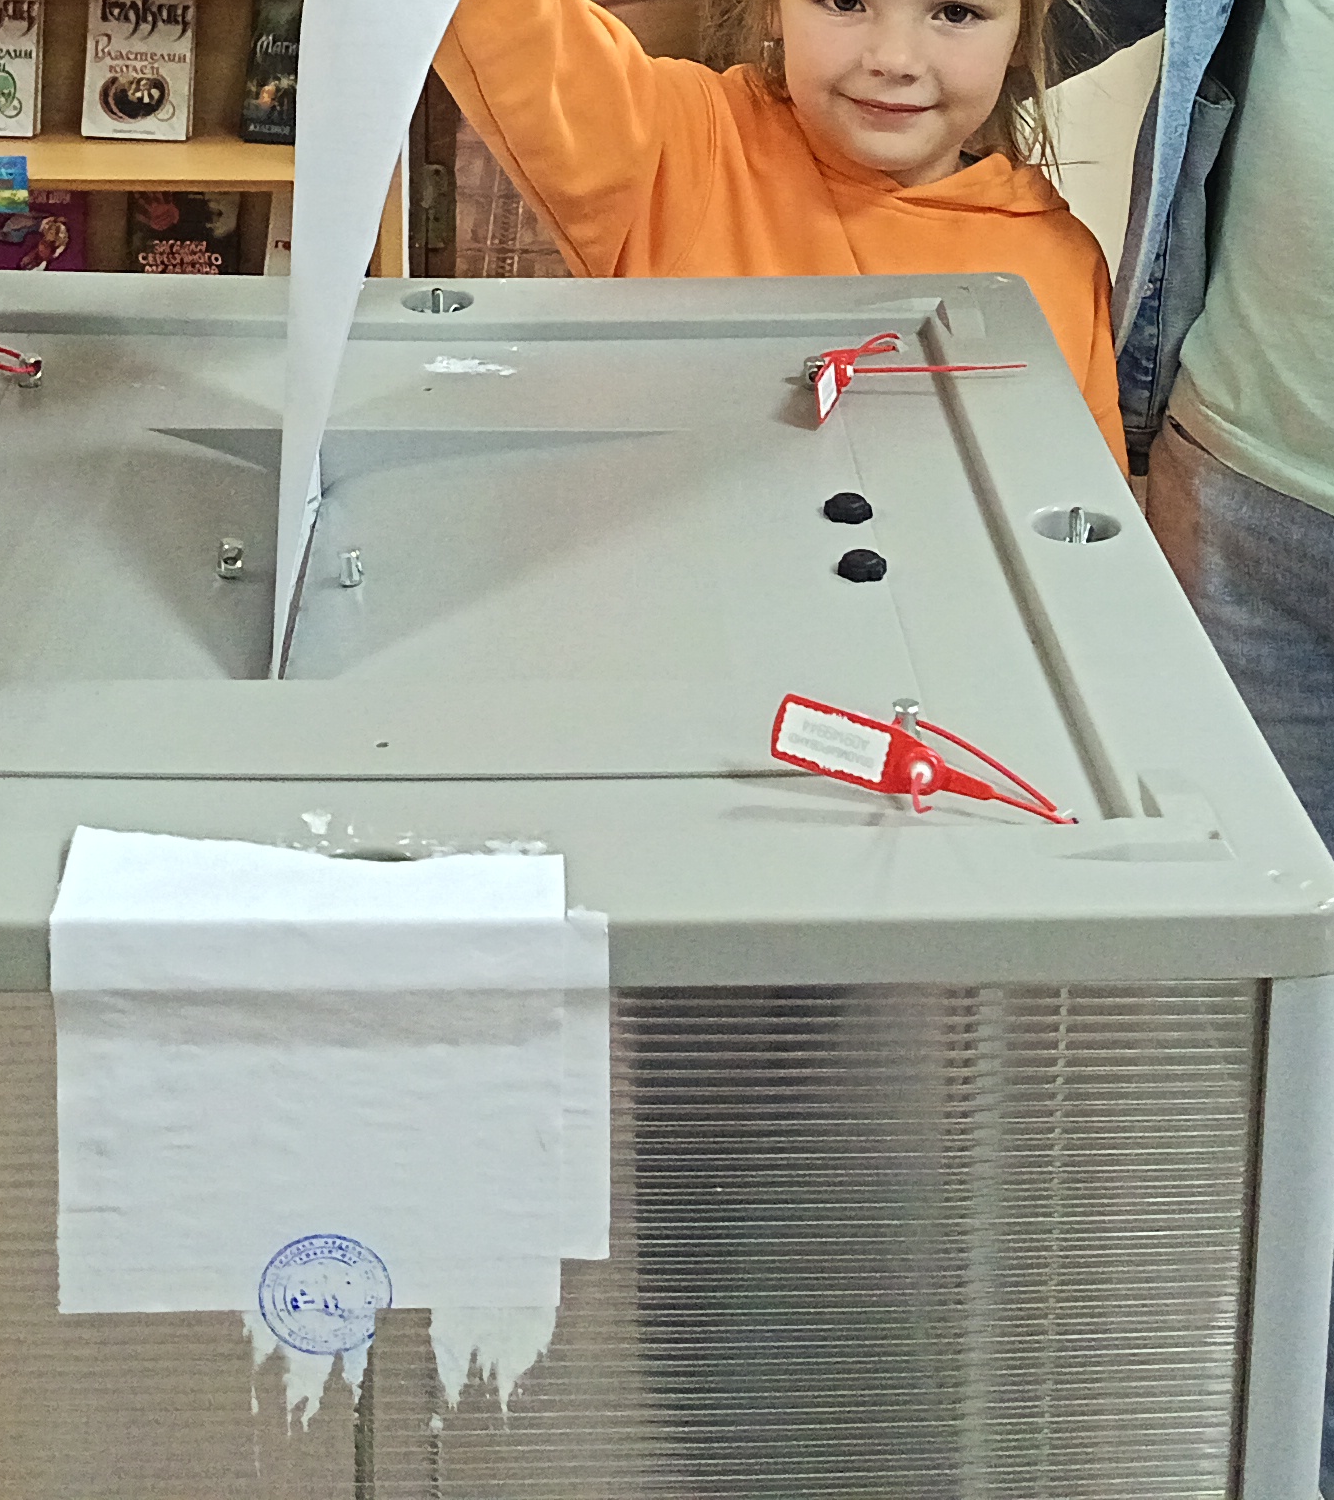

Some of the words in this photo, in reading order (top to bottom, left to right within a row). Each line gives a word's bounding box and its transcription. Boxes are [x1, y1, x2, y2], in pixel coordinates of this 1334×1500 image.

[93, 32, 189, 64] Властелин
[108, 63, 160, 76] колец
[152, 240, 207, 252] ЗАГАДКА
[138, 252, 222, 265] СЕРЕБРЯНОГО
